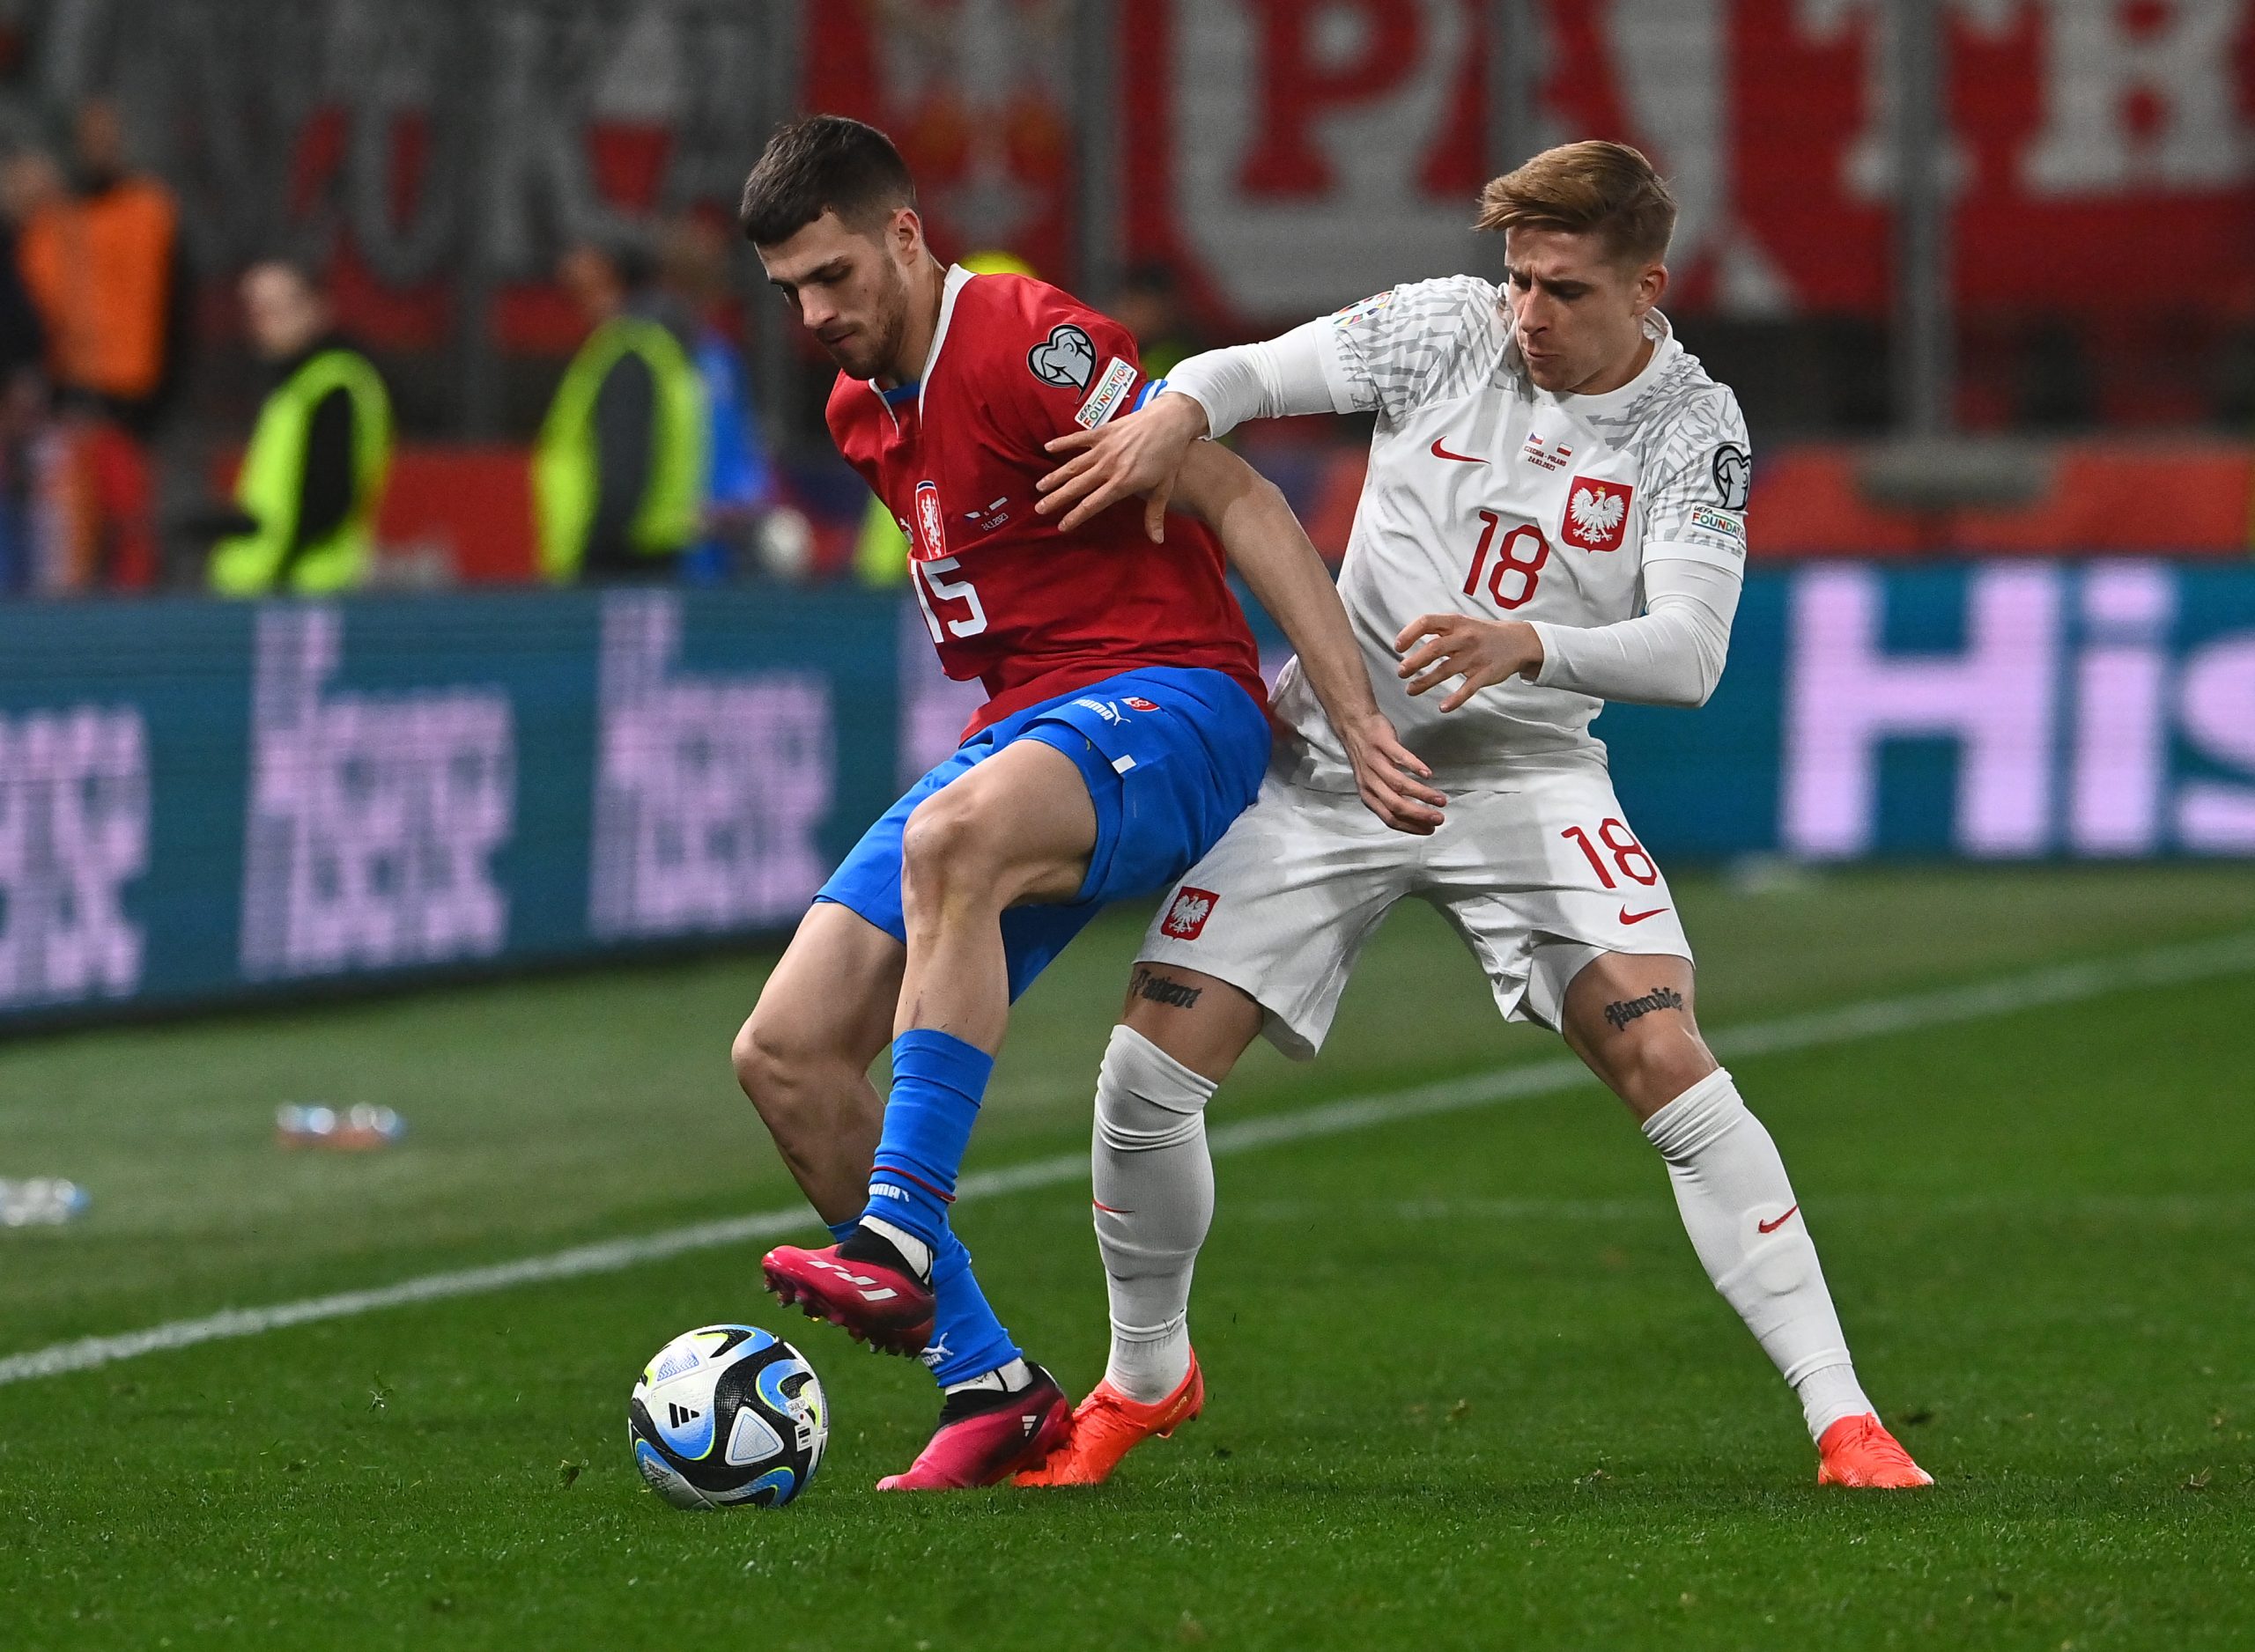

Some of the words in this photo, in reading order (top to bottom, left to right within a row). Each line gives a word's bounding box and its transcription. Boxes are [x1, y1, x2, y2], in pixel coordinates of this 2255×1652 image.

[1078, 404, 1091, 421] UEFA
[1083, 363, 1128, 427] FOUNDATION
[1524, 446, 1544, 458] CZECHIA
[1548, 454, 1567, 467] POLAND
[1694, 505, 1713, 514] UEFA
[1463, 510, 1549, 610] 18
[911, 557, 987, 644] 15
[1561, 818, 1657, 889] 18
[869, 1183, 900, 1199] UMA
